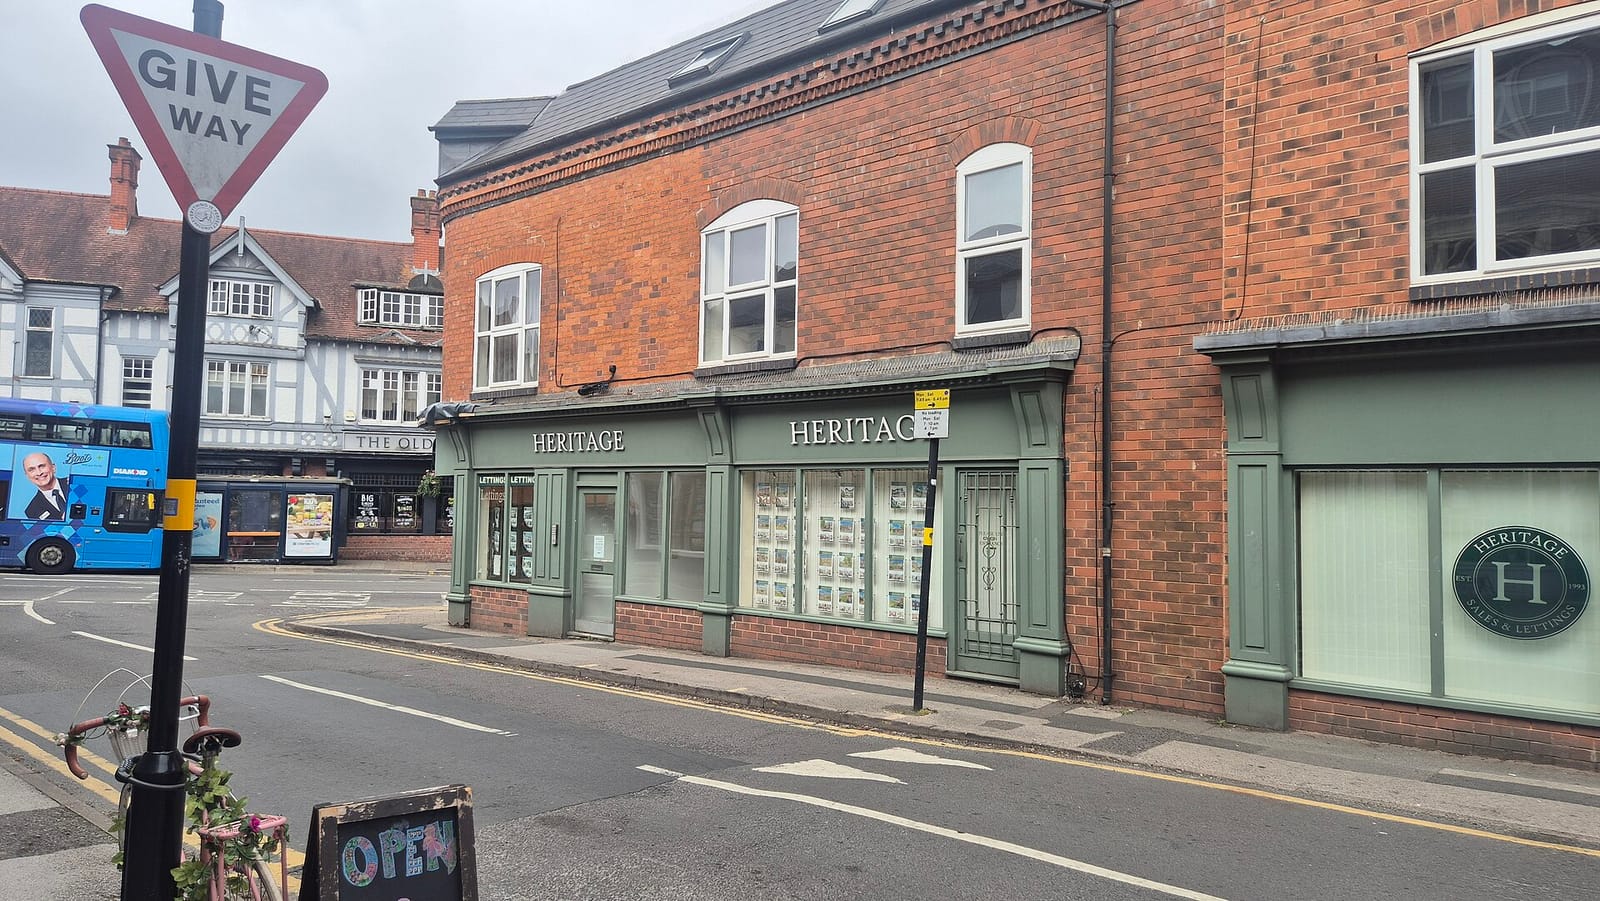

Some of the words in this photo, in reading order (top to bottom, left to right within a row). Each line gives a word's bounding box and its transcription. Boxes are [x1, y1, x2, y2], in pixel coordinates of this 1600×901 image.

[138, 50, 272, 116] GIVE
[168, 104, 252, 146] WAY
[356, 436, 390, 448] THE
[399, 438, 432, 449] OLD
[533, 430, 625, 452] HERITAGE
[789, 415, 914, 444] HERITAG
[1474, 531, 1568, 560] HERITAGE
[1492, 561, 1547, 604] H
[1466, 599, 1499, 626] SALES
[1501, 622, 1511, 631] &
[1516, 604, 1576, 633] LETTINGS
[342, 820, 457, 887] OPEN
